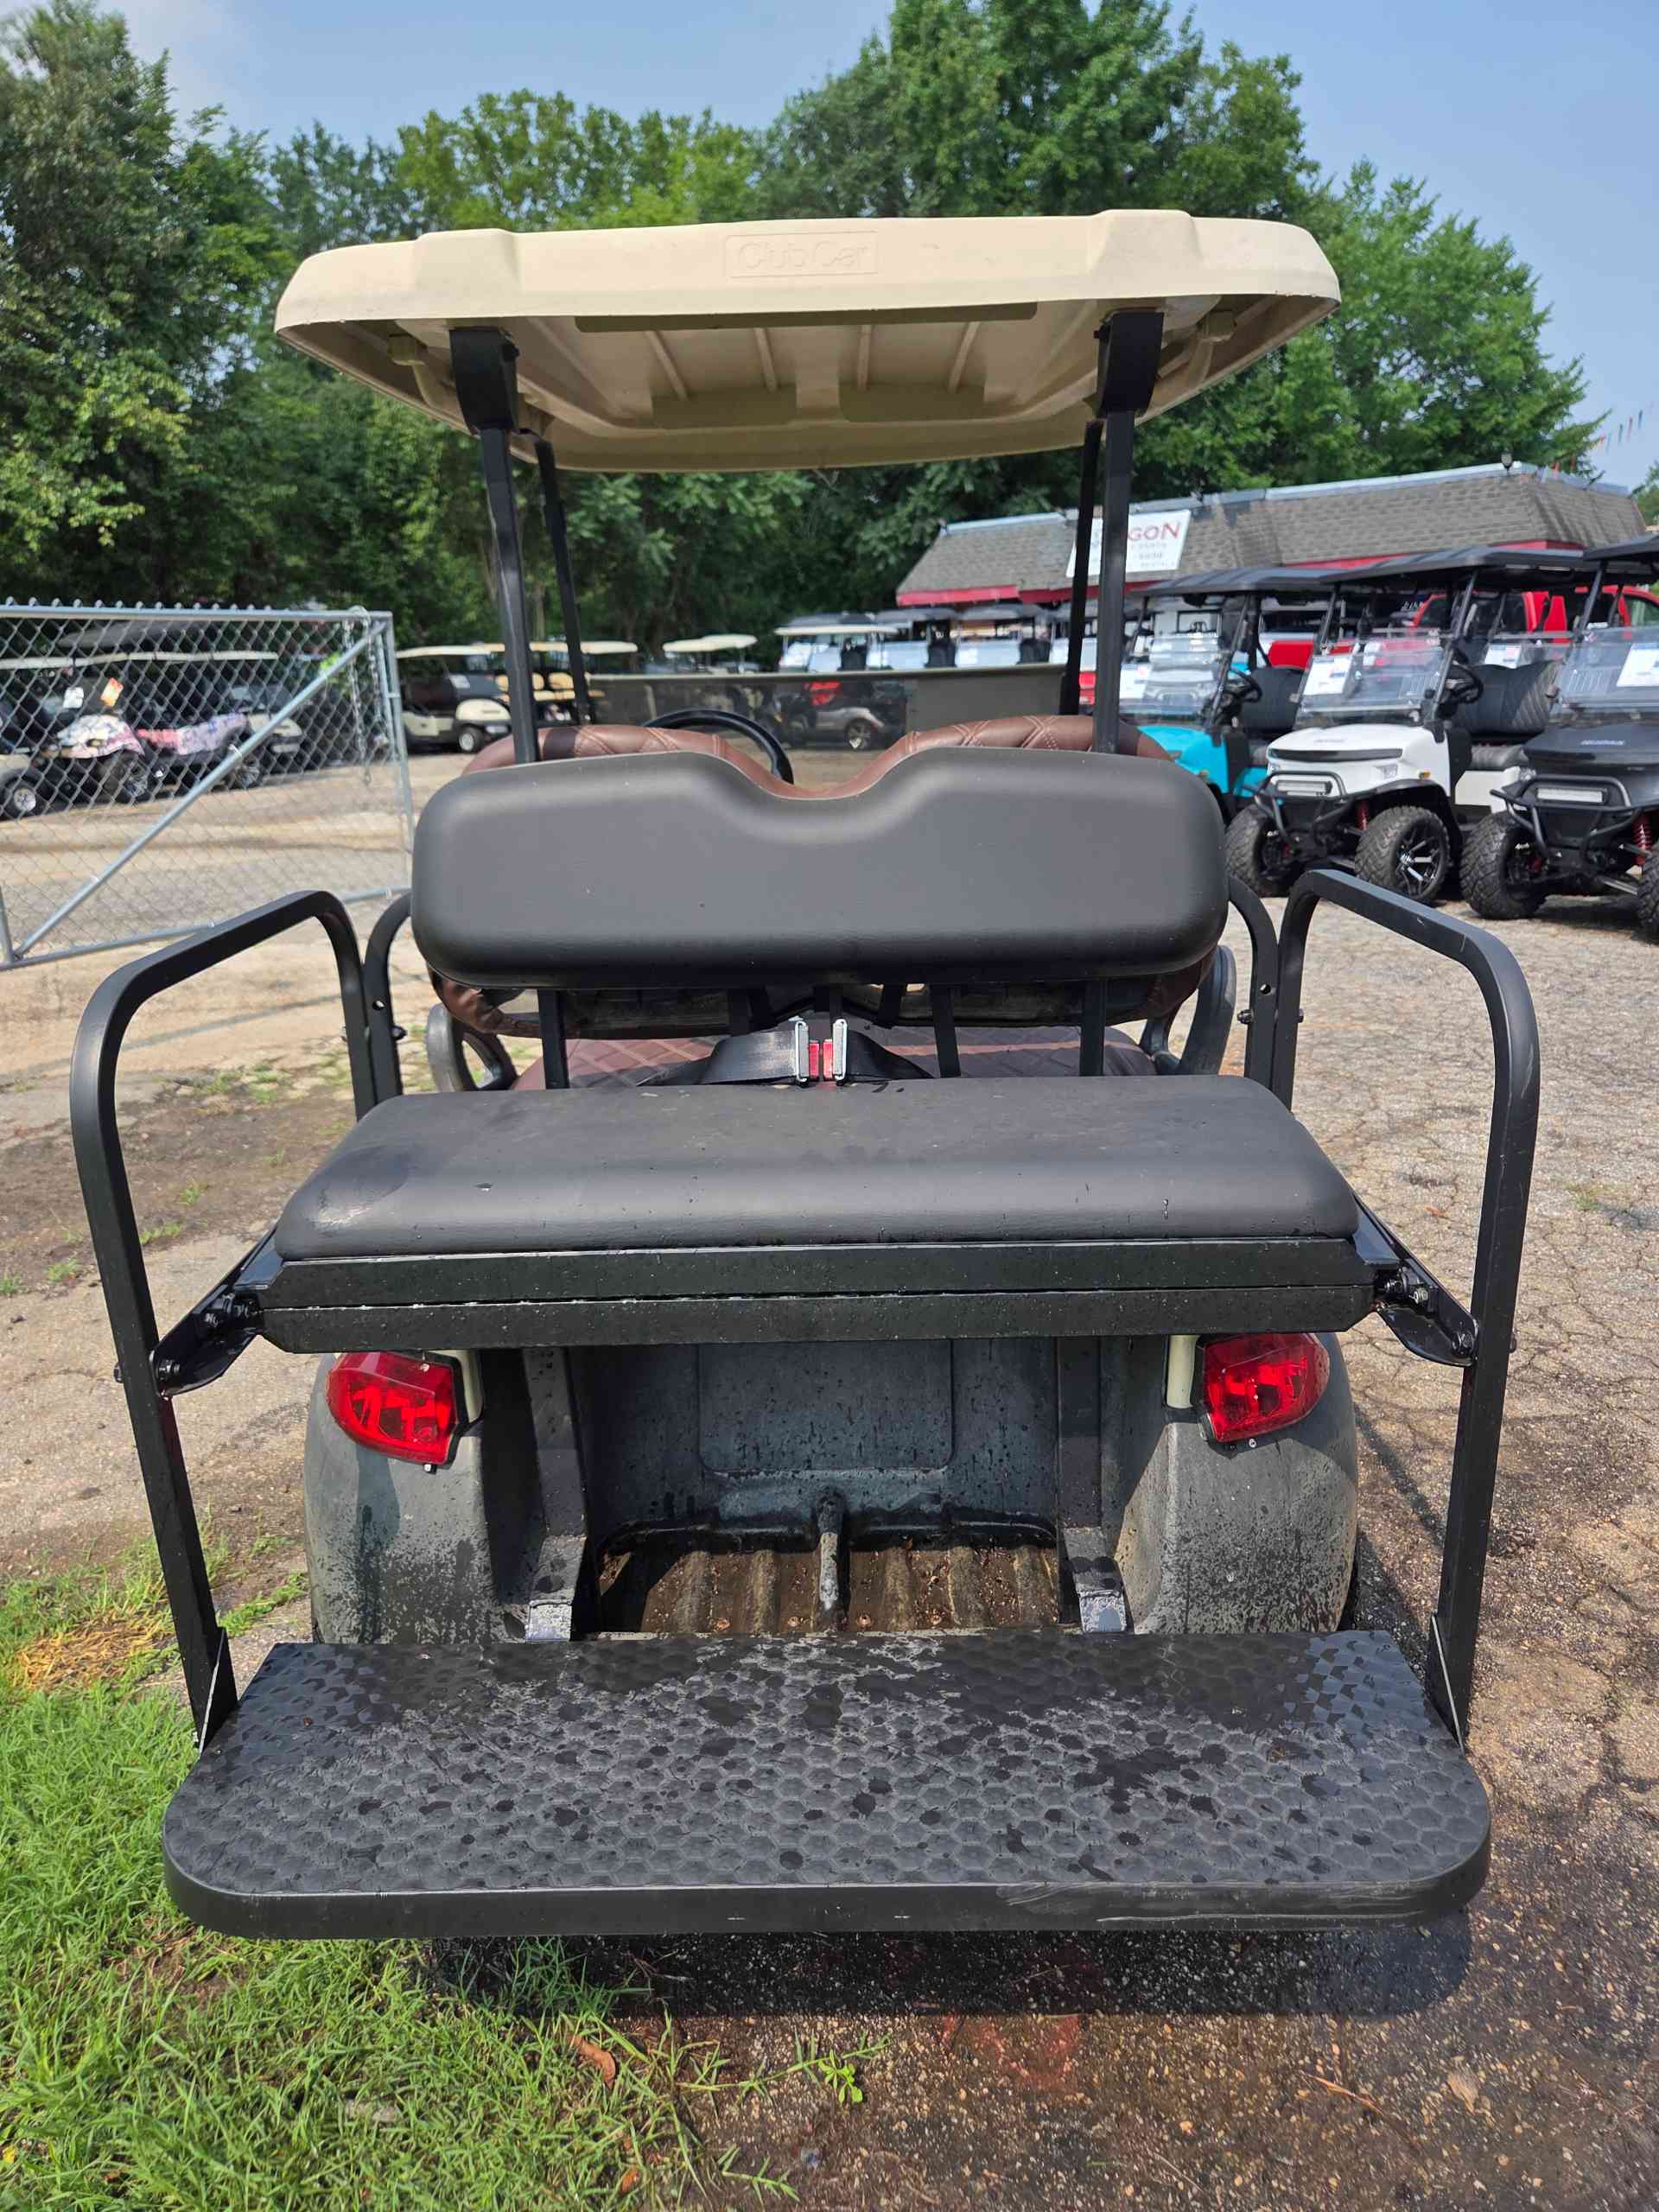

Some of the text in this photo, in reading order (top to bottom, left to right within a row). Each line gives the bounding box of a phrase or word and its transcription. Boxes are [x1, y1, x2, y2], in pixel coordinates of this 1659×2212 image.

[738, 240, 871, 269] Club Car
[1127, 523, 1181, 542] GON
